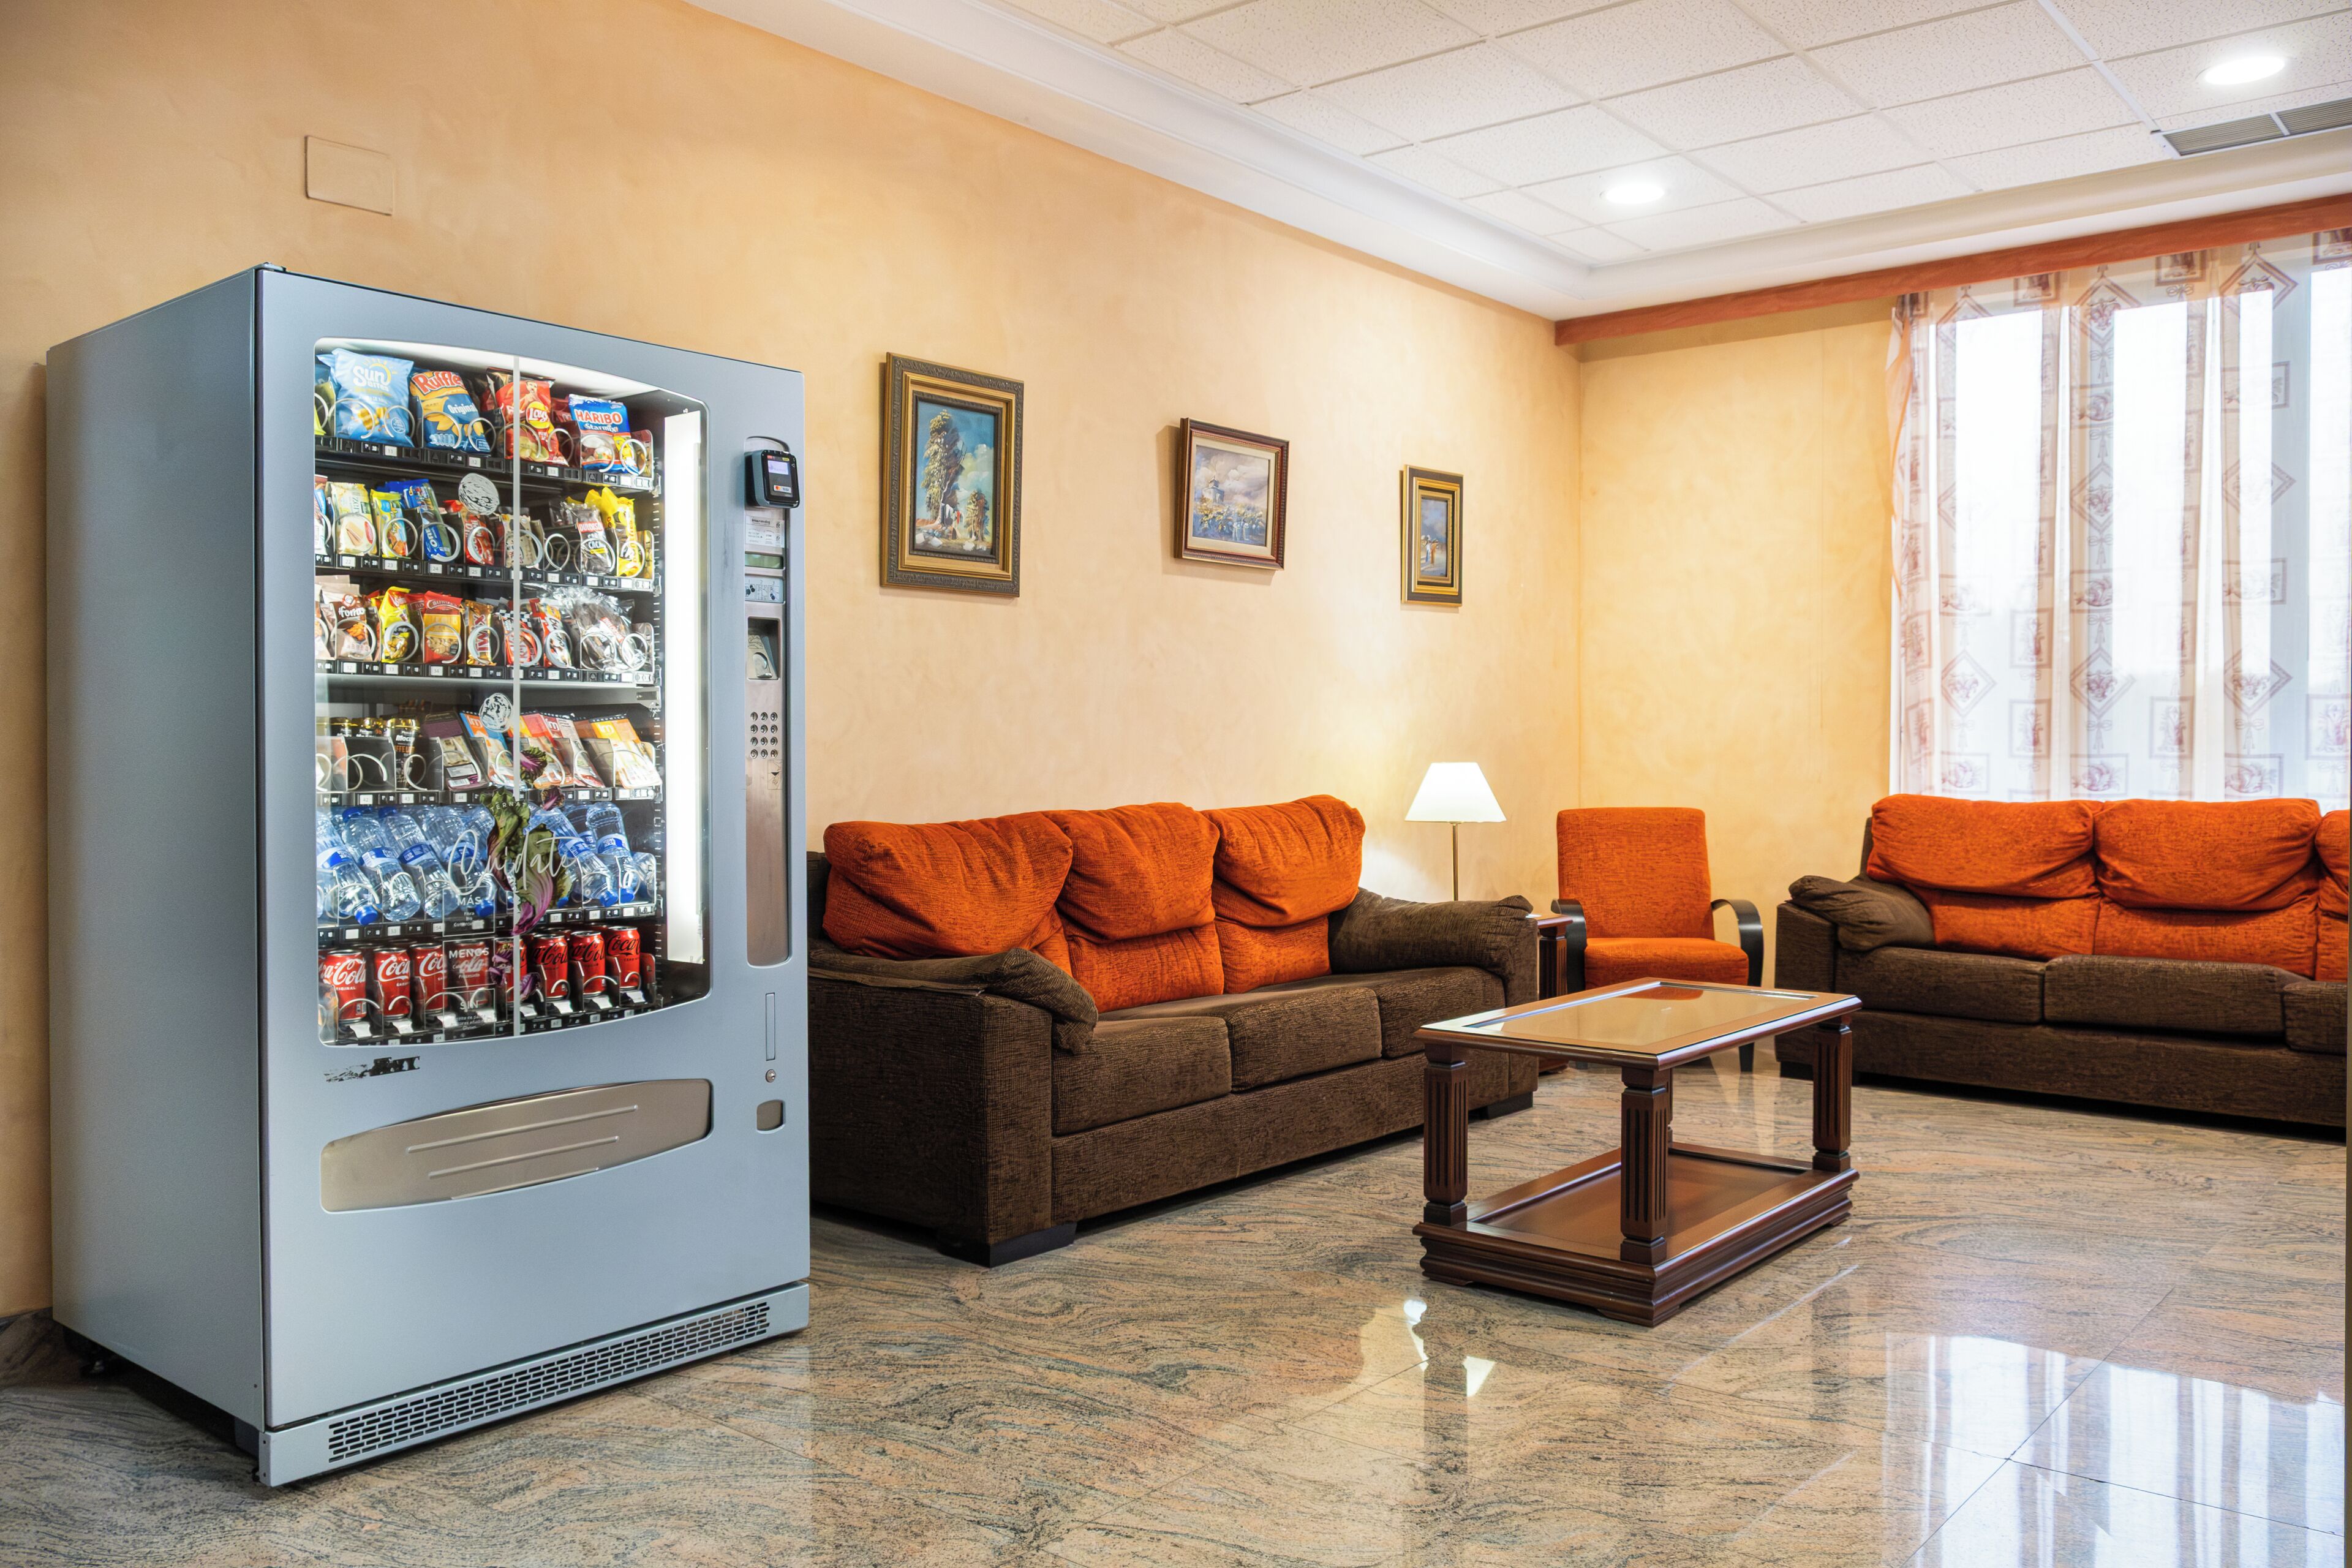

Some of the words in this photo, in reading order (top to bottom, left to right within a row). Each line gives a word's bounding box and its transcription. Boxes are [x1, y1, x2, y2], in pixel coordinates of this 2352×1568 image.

[353, 366, 389, 387] Sun
[574, 409, 622, 425] HARIBO
[584, 423, 618, 432] Starmix
[473, 614, 490, 652] TWX
[458, 895, 482, 906] MÁS
[449, 947, 489, 959] MENOS
[460, 1001, 478, 1010] SIN
